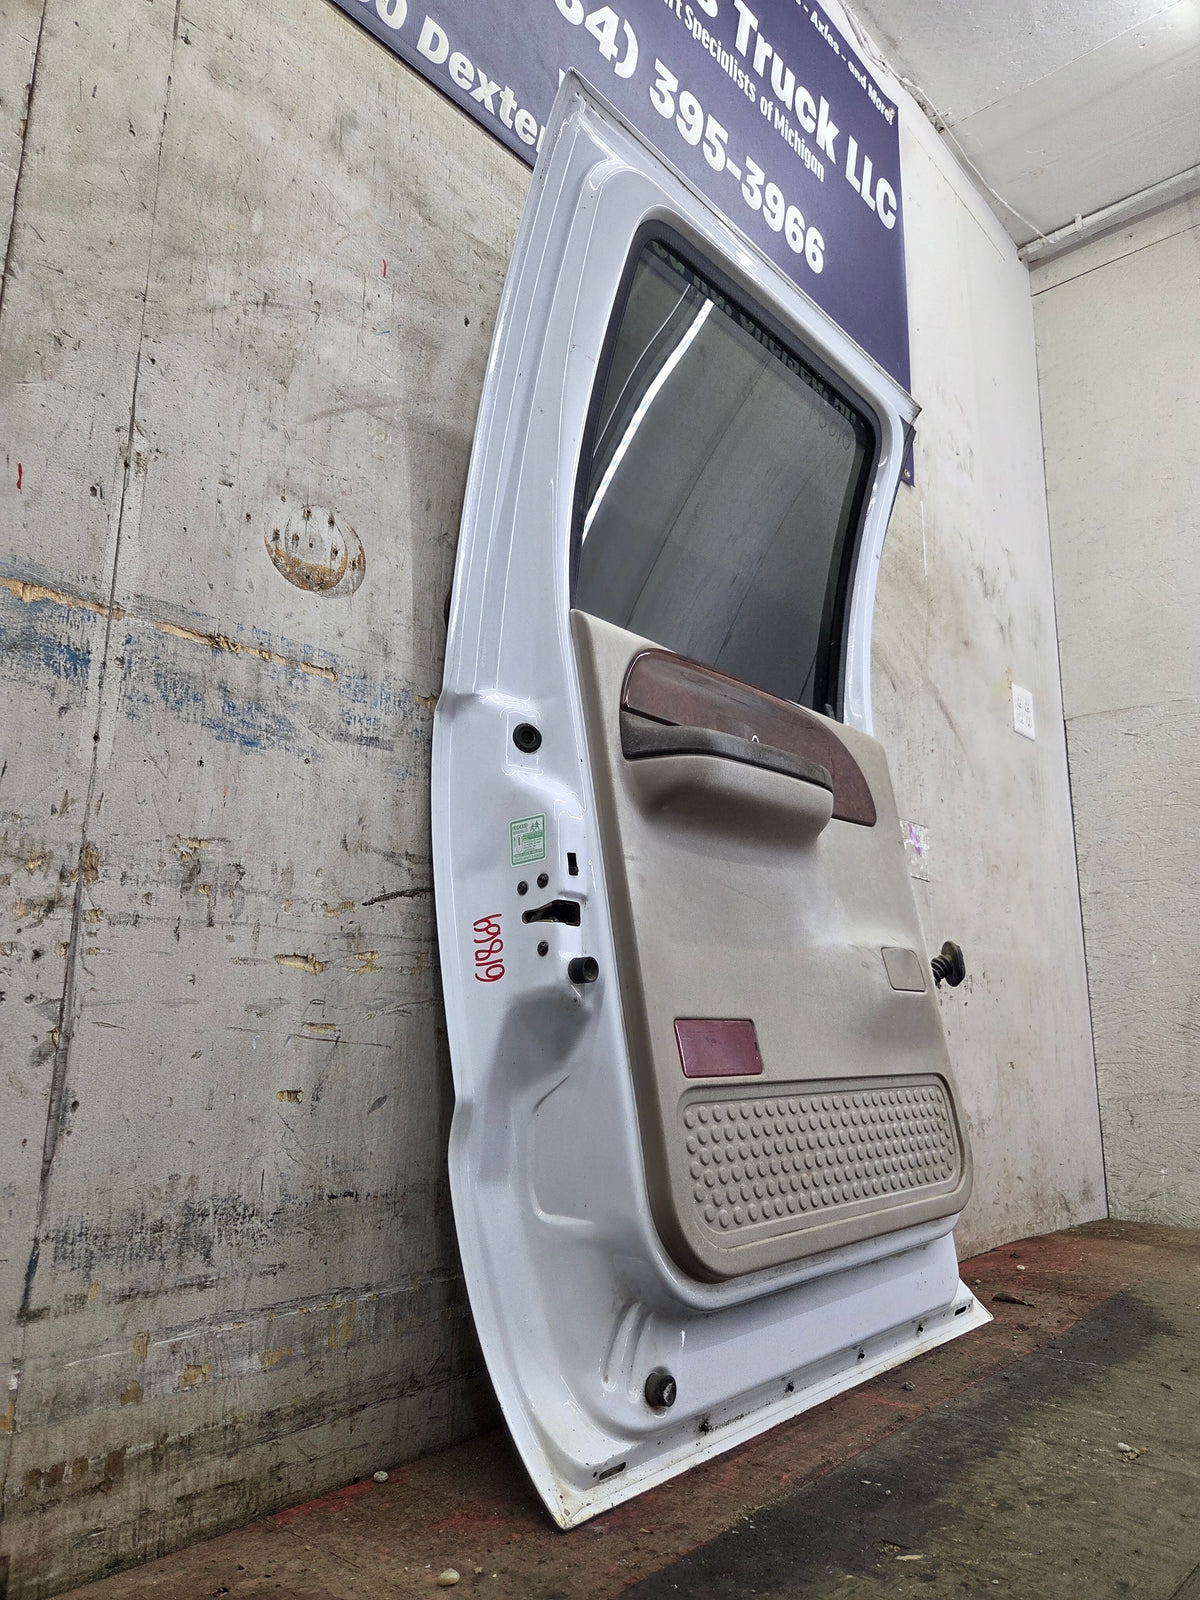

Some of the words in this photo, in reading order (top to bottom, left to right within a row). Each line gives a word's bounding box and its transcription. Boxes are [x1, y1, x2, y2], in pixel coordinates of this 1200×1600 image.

[684, 4, 757, 103] Specialists
[760, 96, 774, 122] of
[774, 107, 825, 182] Michigan
[734, 0, 840, 164] Truck
[846, 135, 897, 230] LLC
[810, 10, 840, 55] Axles
[847, 61, 867, 90] and
[649, 57, 825, 274] 395-3966
